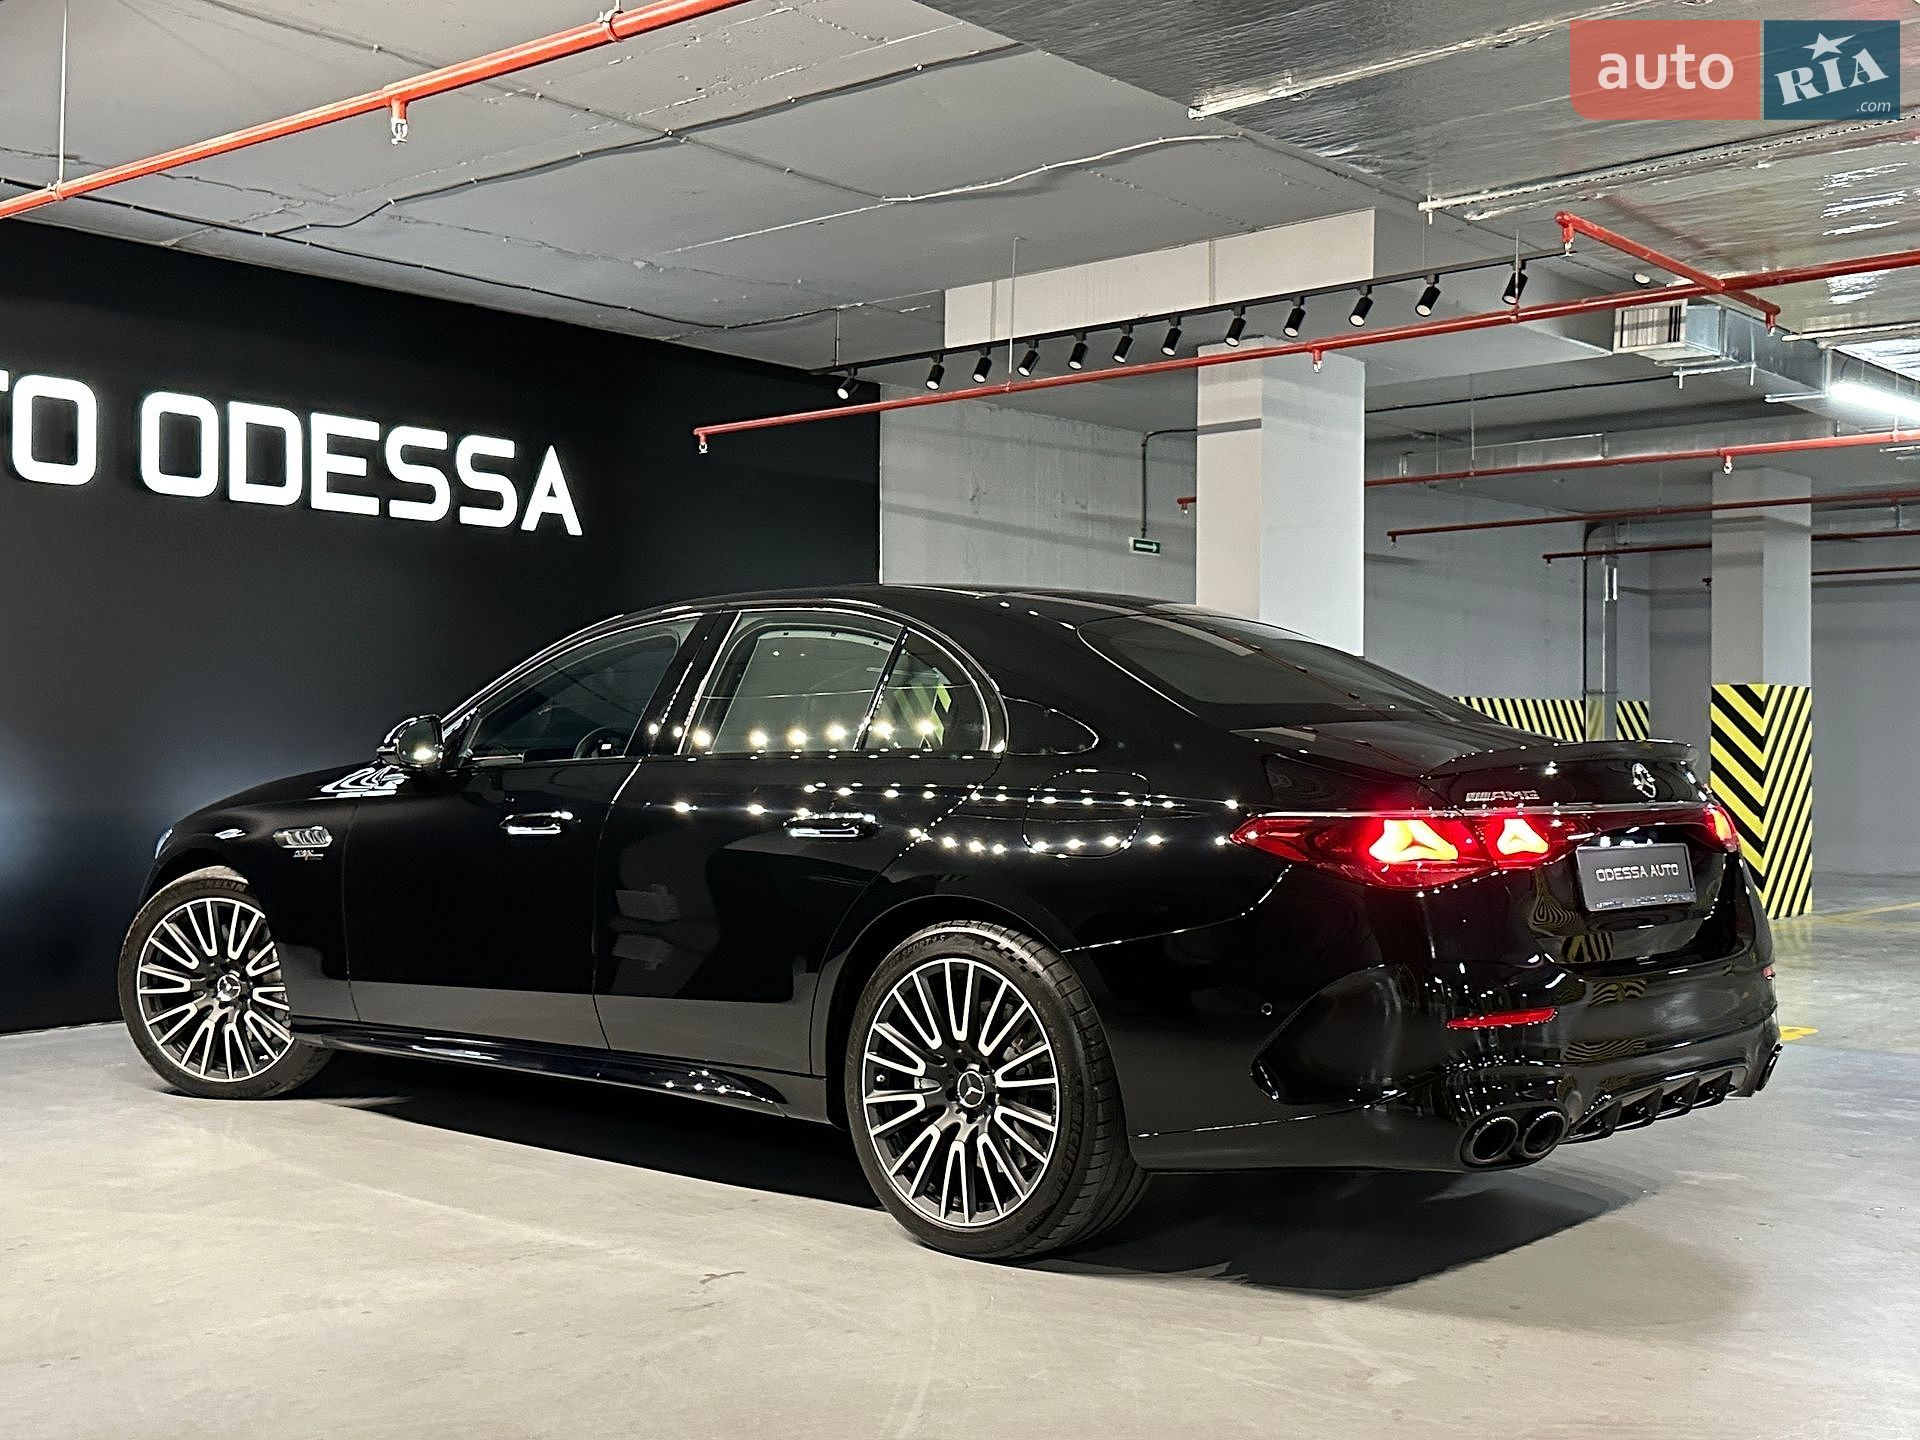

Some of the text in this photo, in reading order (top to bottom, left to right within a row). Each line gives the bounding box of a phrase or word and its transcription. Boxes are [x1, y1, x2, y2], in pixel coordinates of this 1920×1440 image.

[0, 369, 582, 536] O ODESSA
[1595, 863, 1679, 882] ODESSA AUTO
